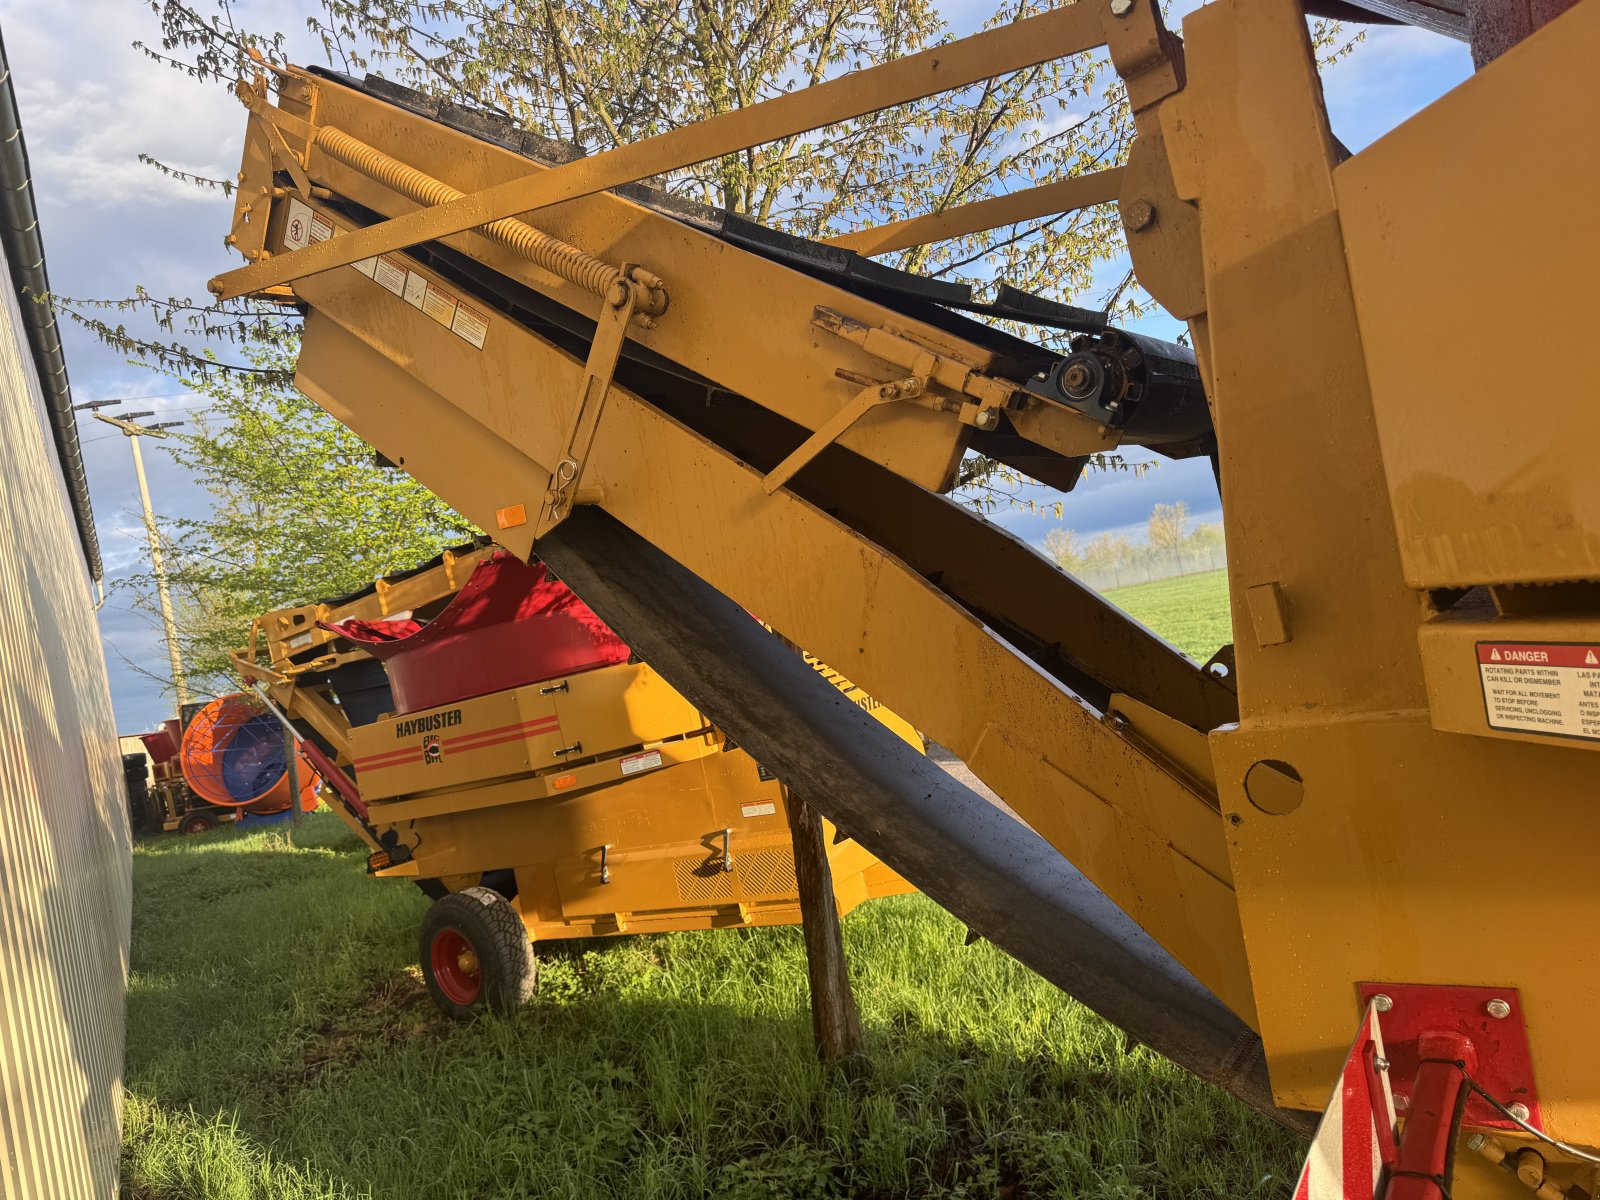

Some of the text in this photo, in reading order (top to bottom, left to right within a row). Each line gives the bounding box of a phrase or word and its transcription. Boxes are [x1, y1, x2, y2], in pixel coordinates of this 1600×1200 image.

[1504, 651, 1548, 662] DANGER
[1485, 667, 1514, 675] ROTATING
[1536, 669, 1559, 677] WITHIN
[1524, 678, 1561, 686] DISMEMBER
[1529, 691, 1560, 699] MOVEMENT
[1516, 698, 1538, 706] BEFORE
[1579, 701, 1599, 709] ANTES
[1525, 708, 1562, 717] UNCLOGGING
[1505, 714, 1536, 723] INSPECTING
[396, 709, 462, 739] HAYBUSTER
